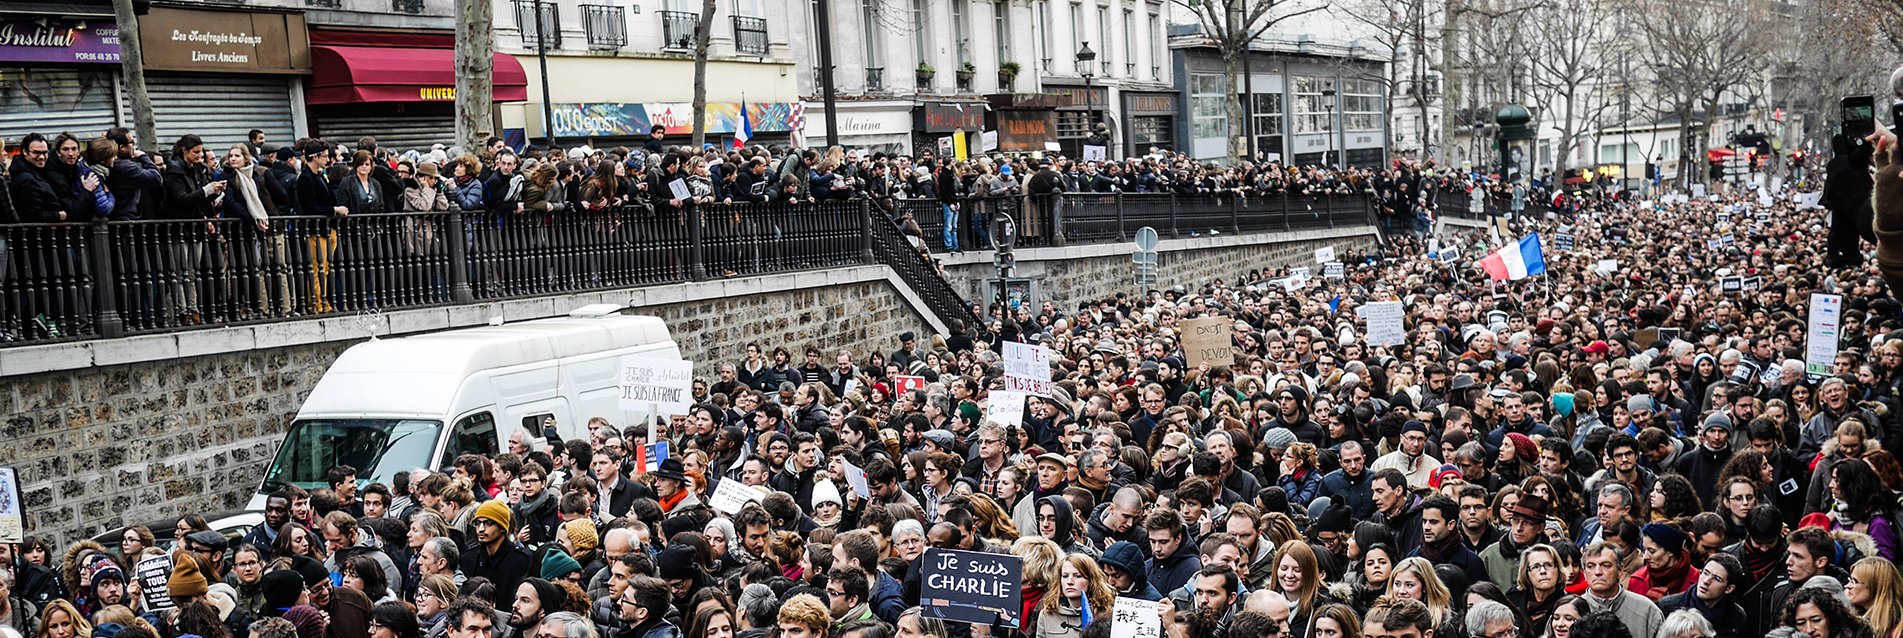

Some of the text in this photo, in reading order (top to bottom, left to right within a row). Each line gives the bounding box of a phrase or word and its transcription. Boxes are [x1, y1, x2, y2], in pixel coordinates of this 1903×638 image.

[0, 23, 75, 47] Institut
[171, 29, 187, 41] Les
[229, 33, 238, 43] du
[238, 33, 262, 47] Temps
[192, 51, 248, 63] Livres Anciens
[584, 117, 617, 131] BOOST
[839, 116, 881, 131] Marina
[1196, 323, 1223, 335] DROIT
[621, 385, 683, 404] JE SUIS LA FRANCE
[937, 552, 1009, 577] Je suis
[146, 575, 167, 586] TOUS
[927, 573, 1013, 598] CHARLIE
